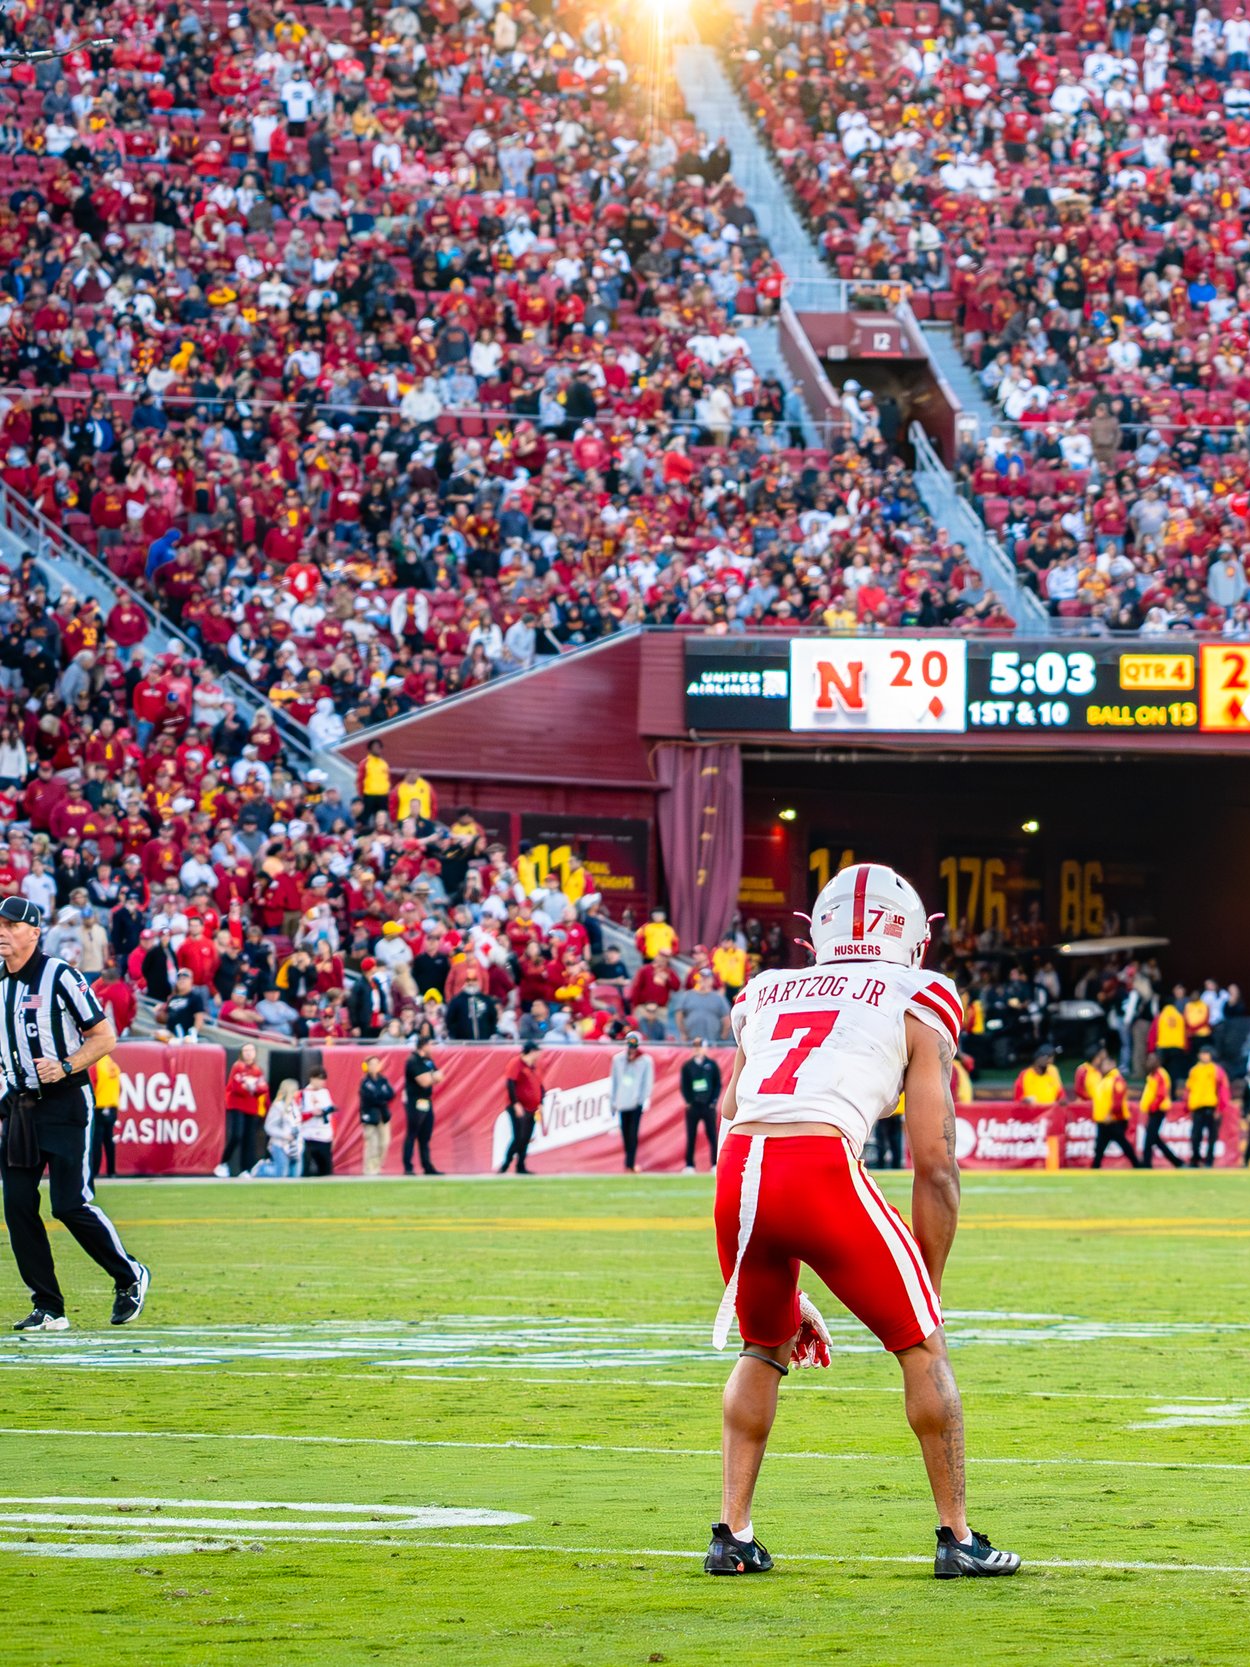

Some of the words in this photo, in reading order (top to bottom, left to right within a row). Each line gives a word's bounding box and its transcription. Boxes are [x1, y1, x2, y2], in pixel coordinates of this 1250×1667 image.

[873, 332, 891, 351] 12
[700, 671, 761, 683] UNITED
[889, 650, 948, 688] 20
[990, 651, 1097, 696] 5:03
[1124, 663, 1166, 682] QTR
[1170, 661, 1187, 681] 4
[686, 683, 761, 696] AIRLINES
[814, 659, 866, 710] N
[968, 701, 1015, 726] 1ST
[1015, 701, 1038, 726] &
[1038, 701, 1070, 726] 10
[1086, 705, 1135, 726] BALL
[1135, 705, 1167, 726] ON
[1168, 702, 1198, 726] 13
[866, 908, 885, 932] 7
[834, 944, 881, 956] HUSKERS
[755, 975, 848, 1014] HARTZOG
[852, 978, 887, 1007] JR
[25, 1022, 39, 1038] C
[757, 1010, 840, 1095] 7
[540, 1091, 612, 1137] Victor
[977, 1117, 1048, 1139] United
